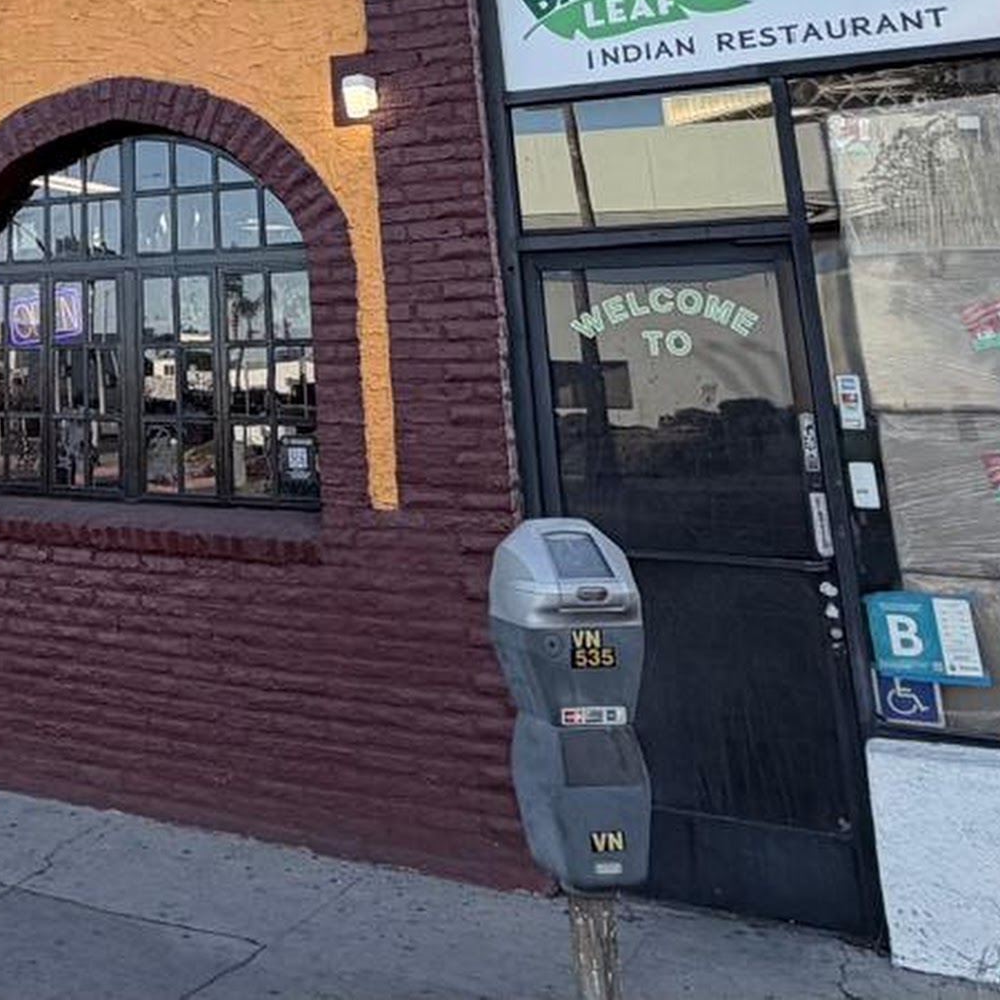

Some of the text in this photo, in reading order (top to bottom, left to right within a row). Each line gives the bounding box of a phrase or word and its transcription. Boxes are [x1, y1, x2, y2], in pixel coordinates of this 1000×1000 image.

[587, 7, 950, 70] INDIAN RESTAURANT
[570, 286, 760, 340] WELCOME
[641, 329, 692, 357] TO
[572, 629, 600, 649] VN
[885, 614, 923, 656] B
[575, 648, 614, 667] 535
[591, 831, 624, 851] VN
